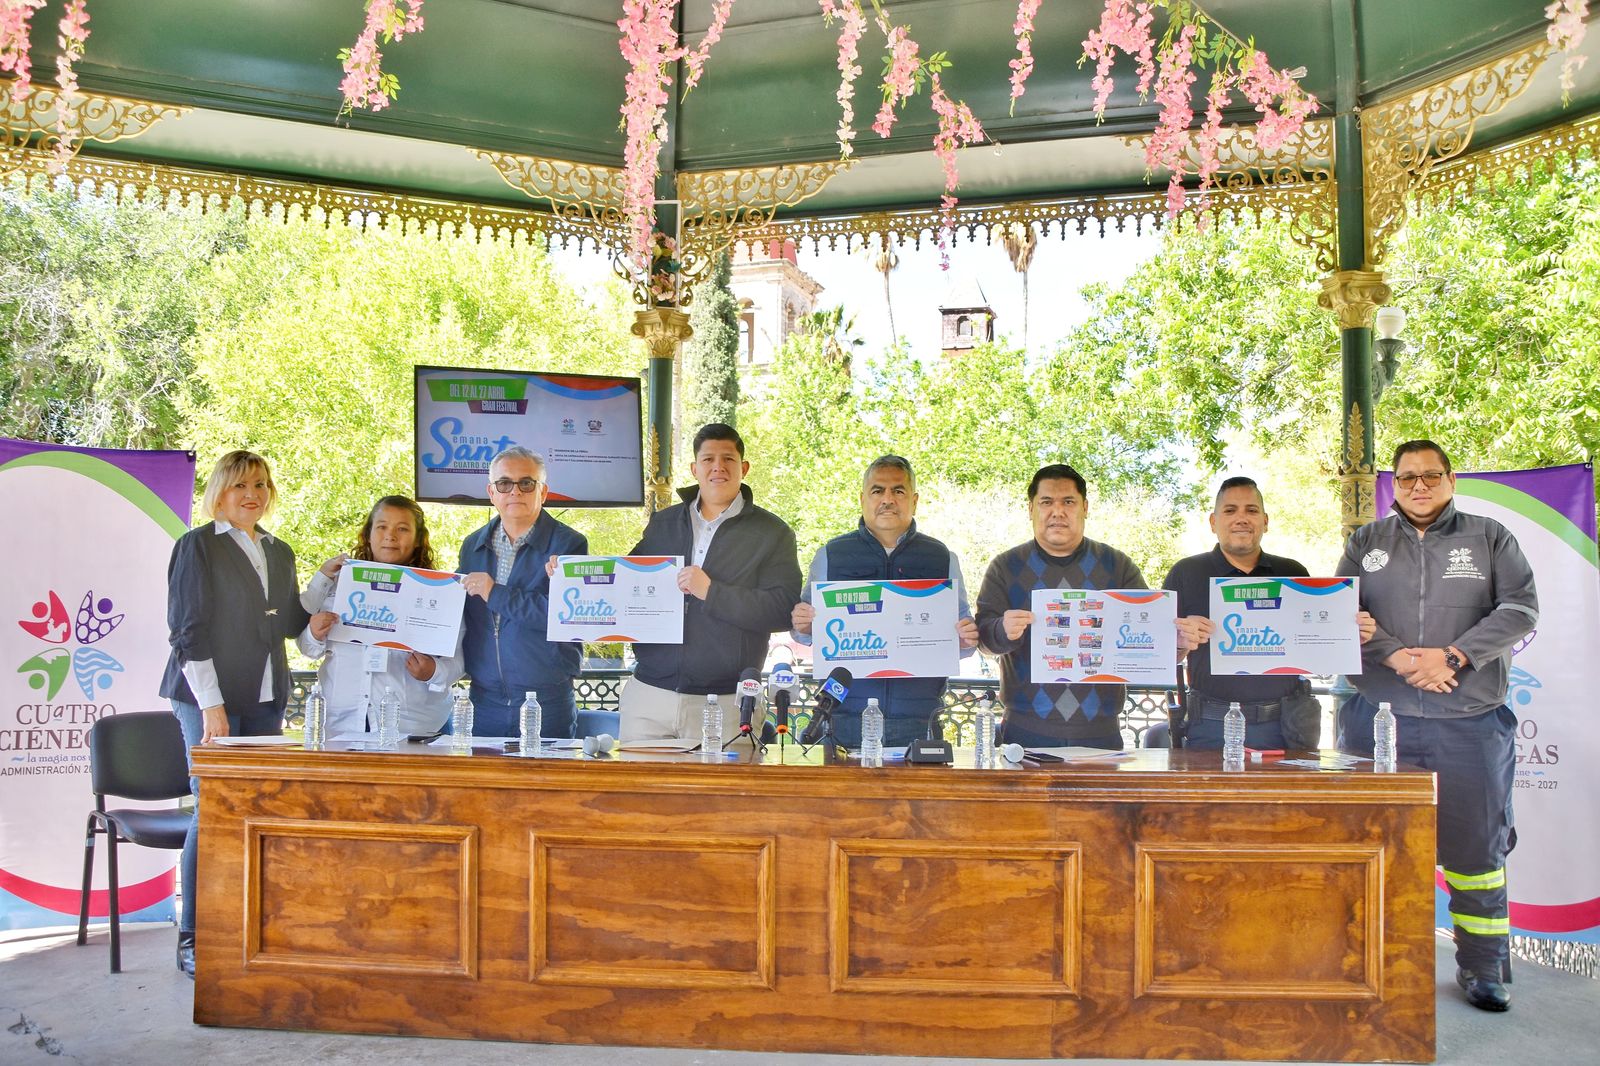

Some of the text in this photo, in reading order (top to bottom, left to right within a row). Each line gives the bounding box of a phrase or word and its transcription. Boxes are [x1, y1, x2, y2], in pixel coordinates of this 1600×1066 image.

[462, 385, 469, 397] 12
[479, 385, 487, 398] 27
[421, 416, 518, 468] Sant
[453, 461, 480, 469] CUATRO
[341, 591, 398, 623] Santa
[558, 587, 616, 621] Santa
[822, 618, 887, 658] Santa
[1116, 624, 1154, 648] Santa
[1218, 613, 1285, 652] Santa
[0, 726, 91, 751] CIÉNE
[1, 763, 81, 776] ADMINISTRACIÓN
[27, 752, 37, 763] la
[39, 754, 69, 764] magia
[71, 754, 86, 762] nos
[1538, 780, 1558, 790] 2027
